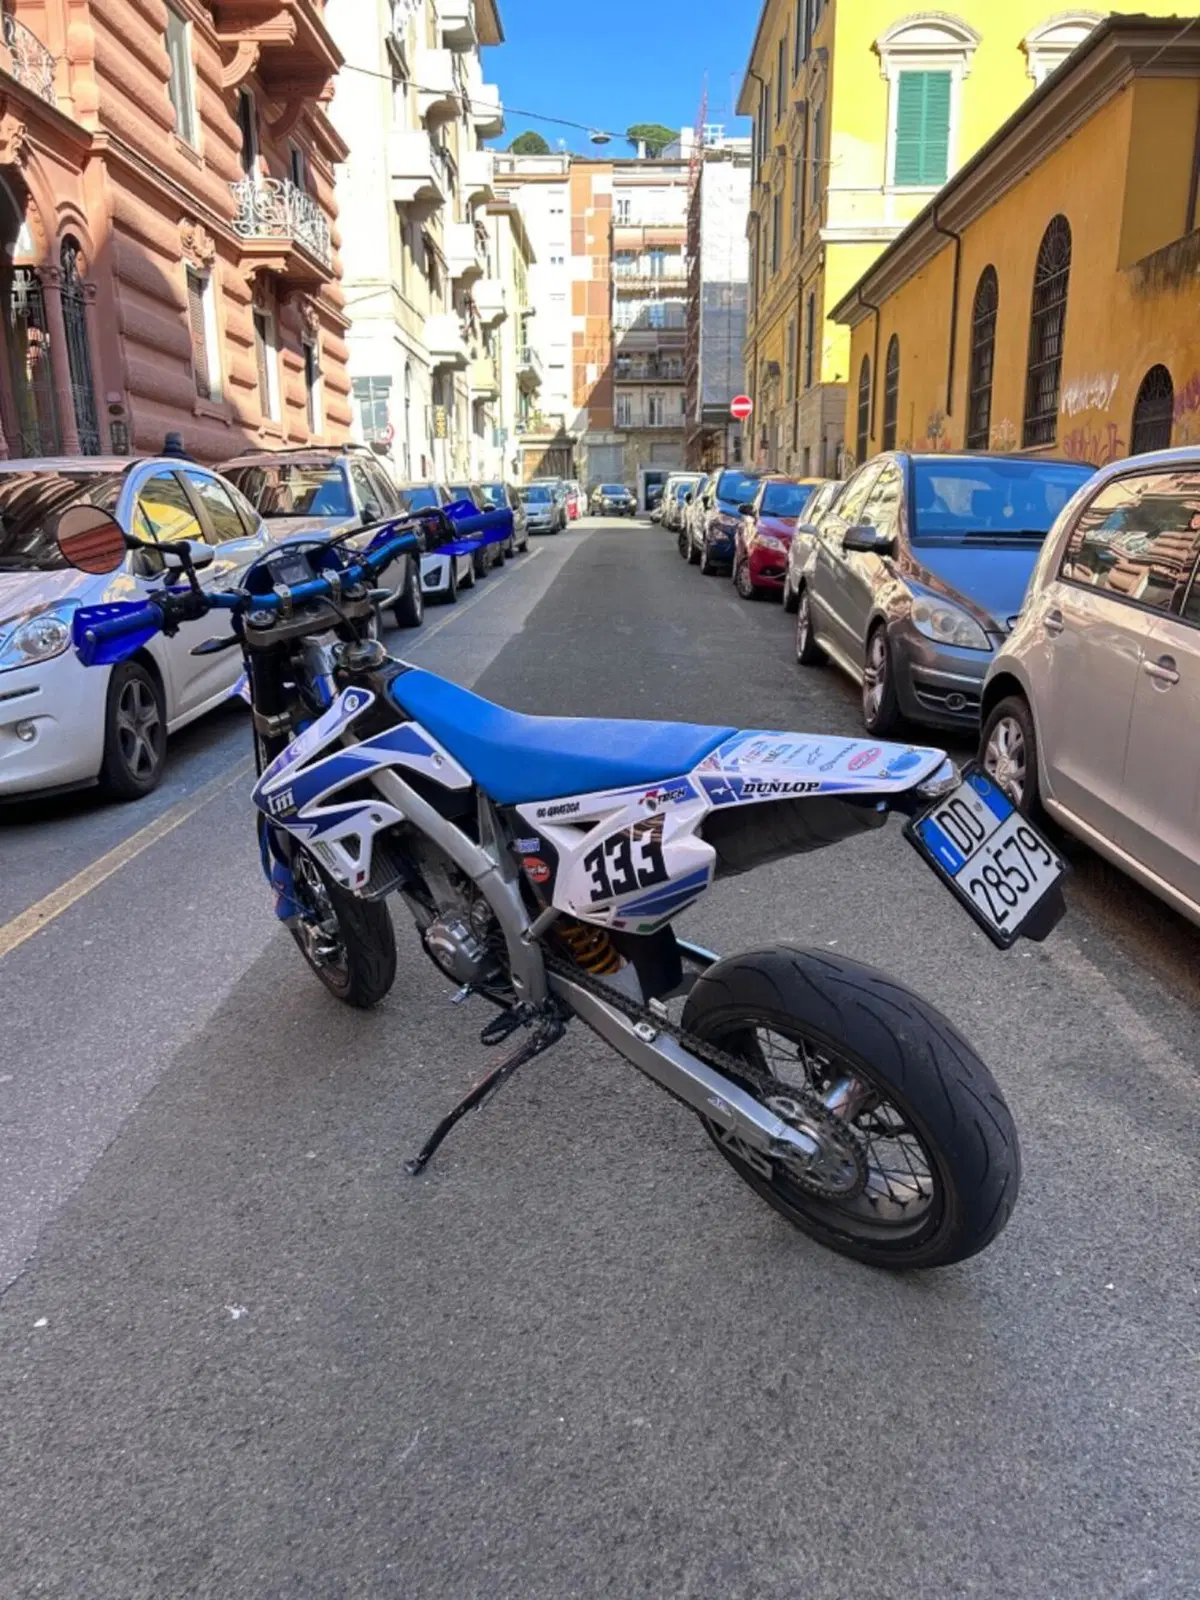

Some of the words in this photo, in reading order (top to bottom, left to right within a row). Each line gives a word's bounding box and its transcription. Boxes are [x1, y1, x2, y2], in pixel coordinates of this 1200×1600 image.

[743, 782, 819, 793] DUNLOP
[584, 811, 671, 902] 333
[936, 798, 985, 856] DD
[969, 826, 1052, 923] 28579
